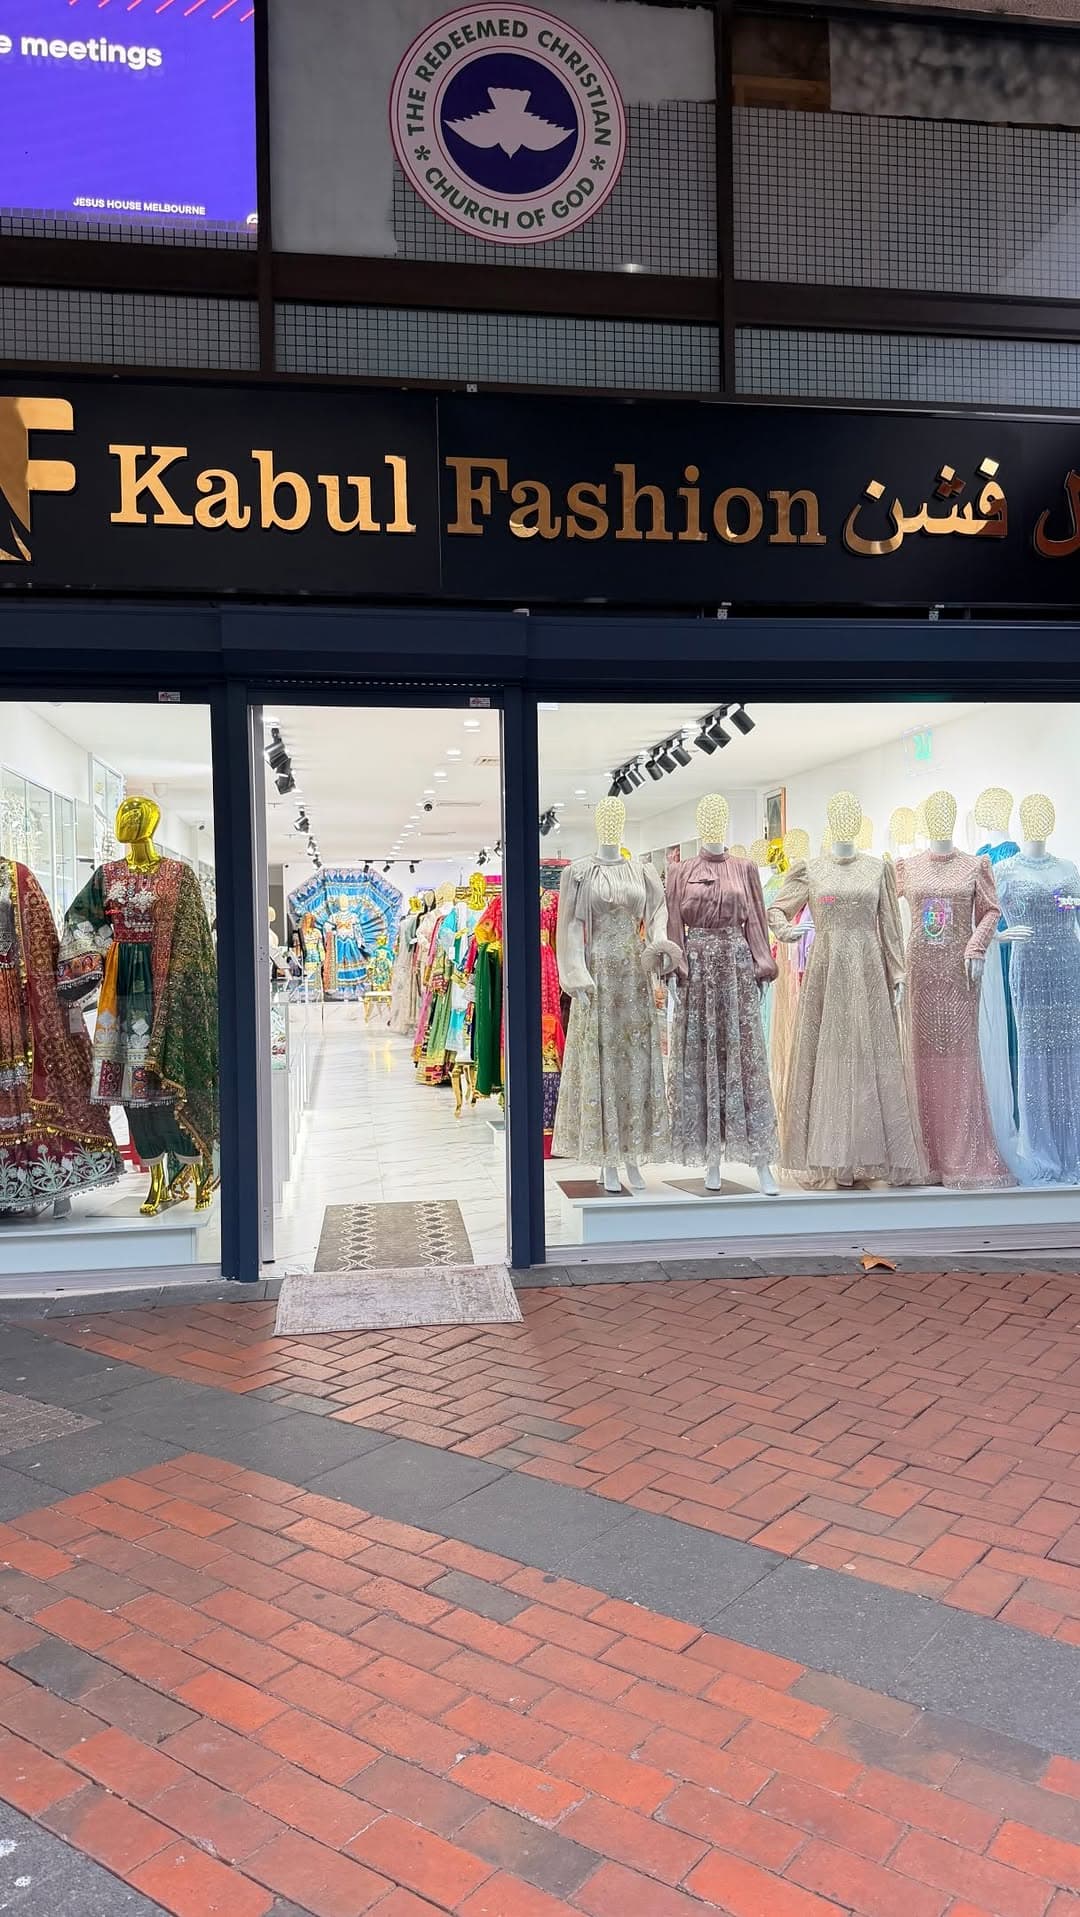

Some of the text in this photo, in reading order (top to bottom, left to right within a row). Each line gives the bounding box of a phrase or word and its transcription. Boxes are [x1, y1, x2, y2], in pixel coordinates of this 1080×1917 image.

[21, 36, 162, 70] meetings
[406, 19, 612, 147] THE REDEEMED CHRISTIAN
[73, 197, 206, 216] JESUS HOUSE MELBOURNE
[425, 167, 595, 229] CHURCH OF GOD
[108, 443, 828, 546] Kabul Fashion
[843, 456, 1008, 555] فشن
